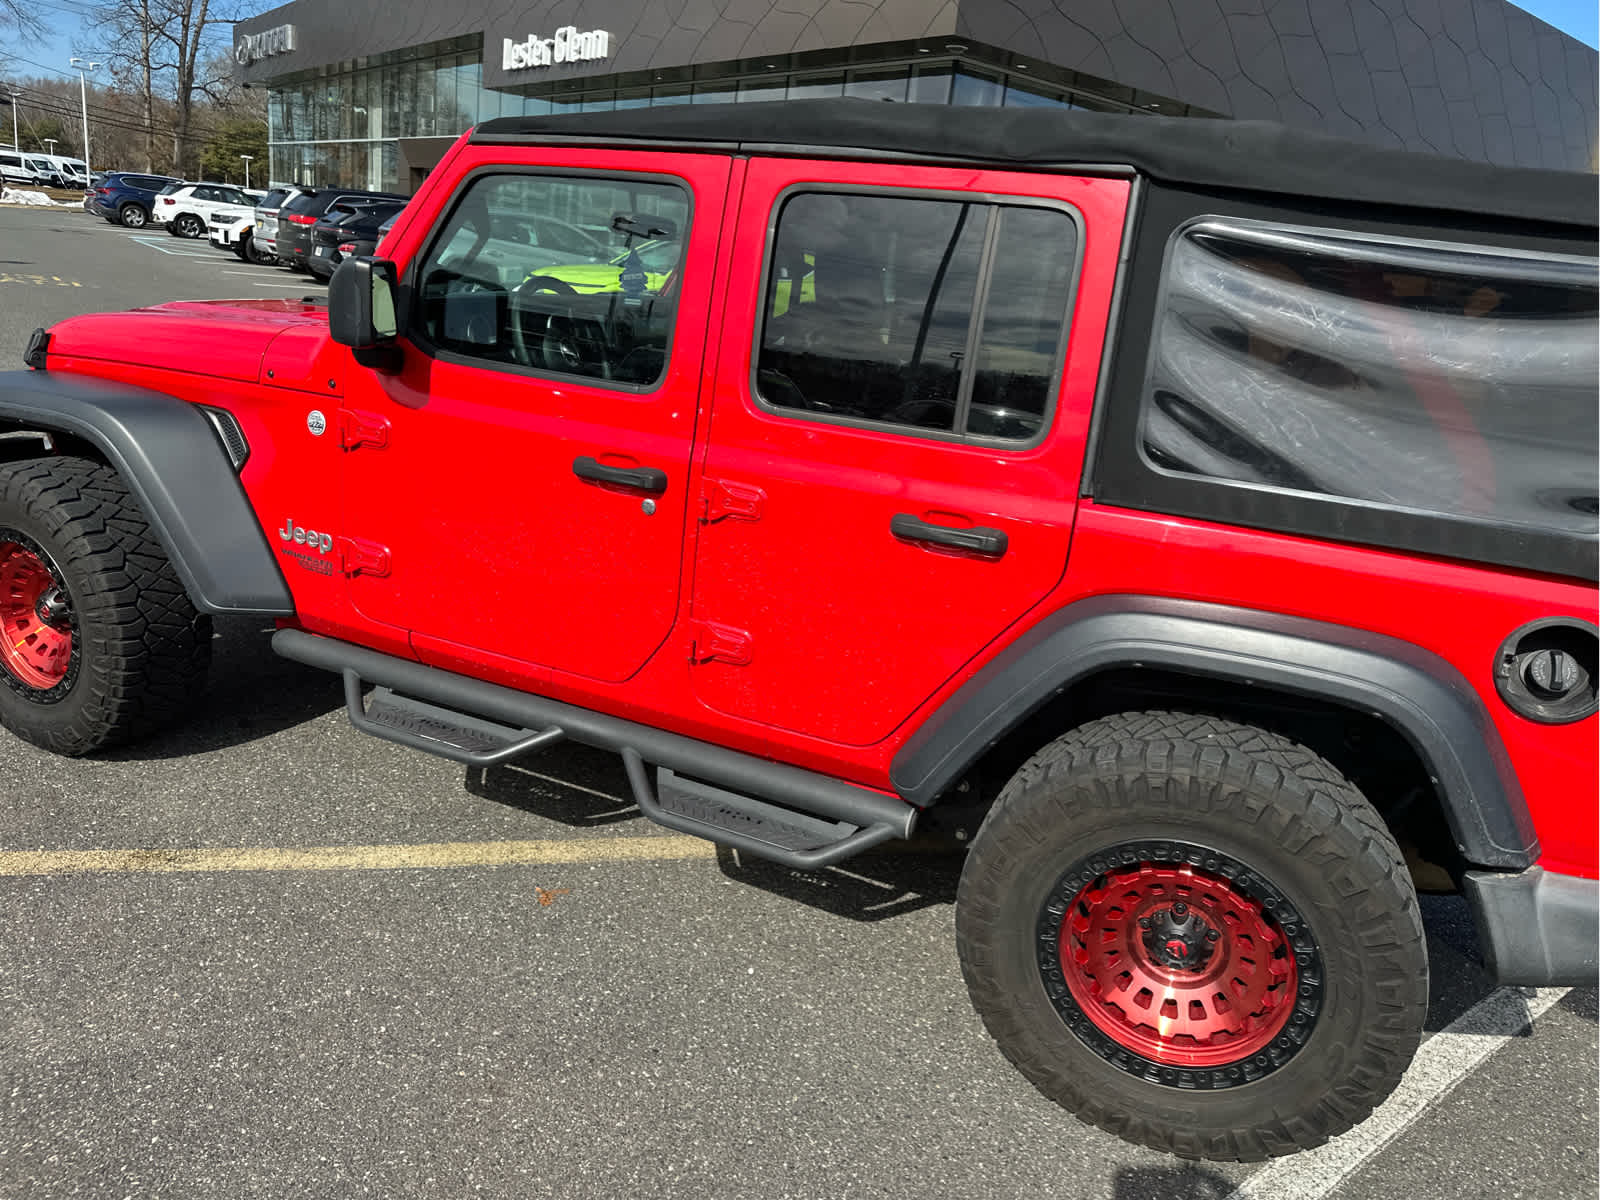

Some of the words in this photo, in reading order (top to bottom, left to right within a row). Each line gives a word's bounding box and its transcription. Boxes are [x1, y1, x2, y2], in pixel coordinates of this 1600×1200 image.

[502, 34, 554, 71] Lester
[554, 26, 609, 63] Glenn
[279, 518, 333, 555] Jeep
